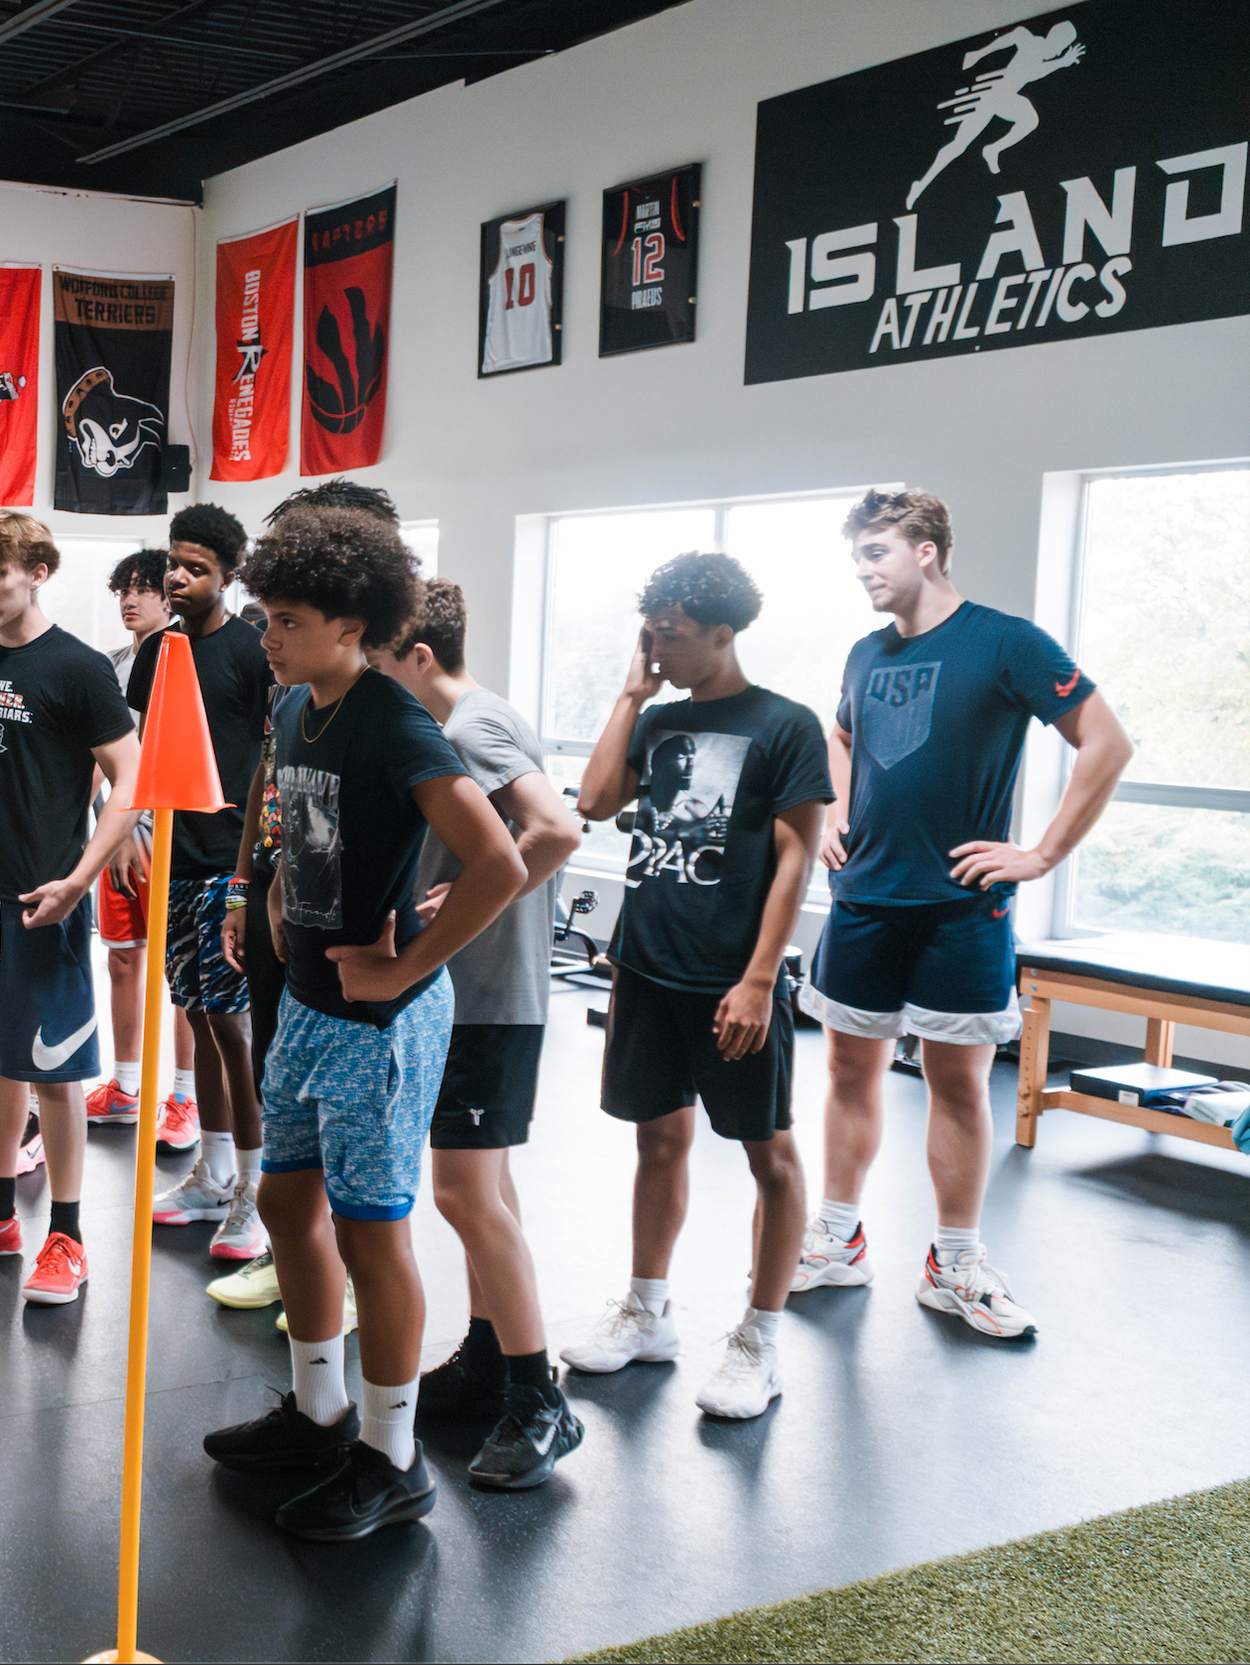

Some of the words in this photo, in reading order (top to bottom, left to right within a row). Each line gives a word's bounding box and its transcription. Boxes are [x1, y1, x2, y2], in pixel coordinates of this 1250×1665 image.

[785, 141, 1249, 315] ISLAND
[59, 276, 118, 299] WOFFORD
[505, 262, 536, 311] 10
[631, 232, 665, 286] 12
[75, 298, 156, 325] TERRIERS
[241, 269, 261, 341] BOSTON
[869, 256, 1132, 353] ATHLETICS
[231, 345, 264, 461] RENEGADES
[870, 667, 935, 708] USA
[625, 828, 725, 889] 2PAC
